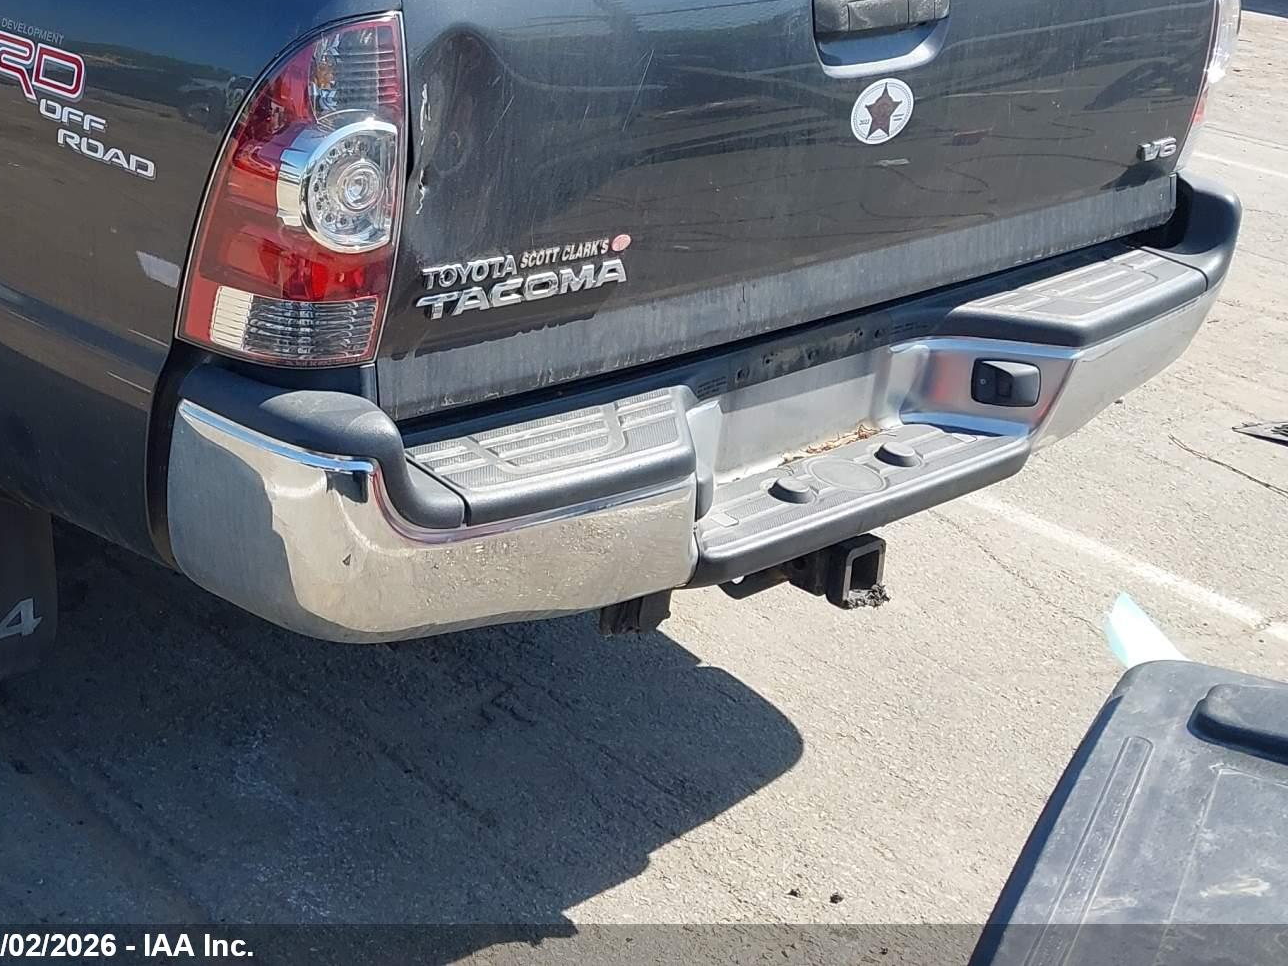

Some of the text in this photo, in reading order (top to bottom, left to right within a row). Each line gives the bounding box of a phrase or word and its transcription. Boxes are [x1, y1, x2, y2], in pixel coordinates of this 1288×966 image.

[2, 16, 65, 45] DEVELOPMENT
[39, 98, 107, 133] OFF
[57, 128, 157, 180] ROAD
[1142, 137, 1177, 162] V6
[520, 238, 610, 269] SCOTT CLARK'S
[416, 258, 627, 321] TACOMA
[421, 255, 518, 291] TOYOTA
